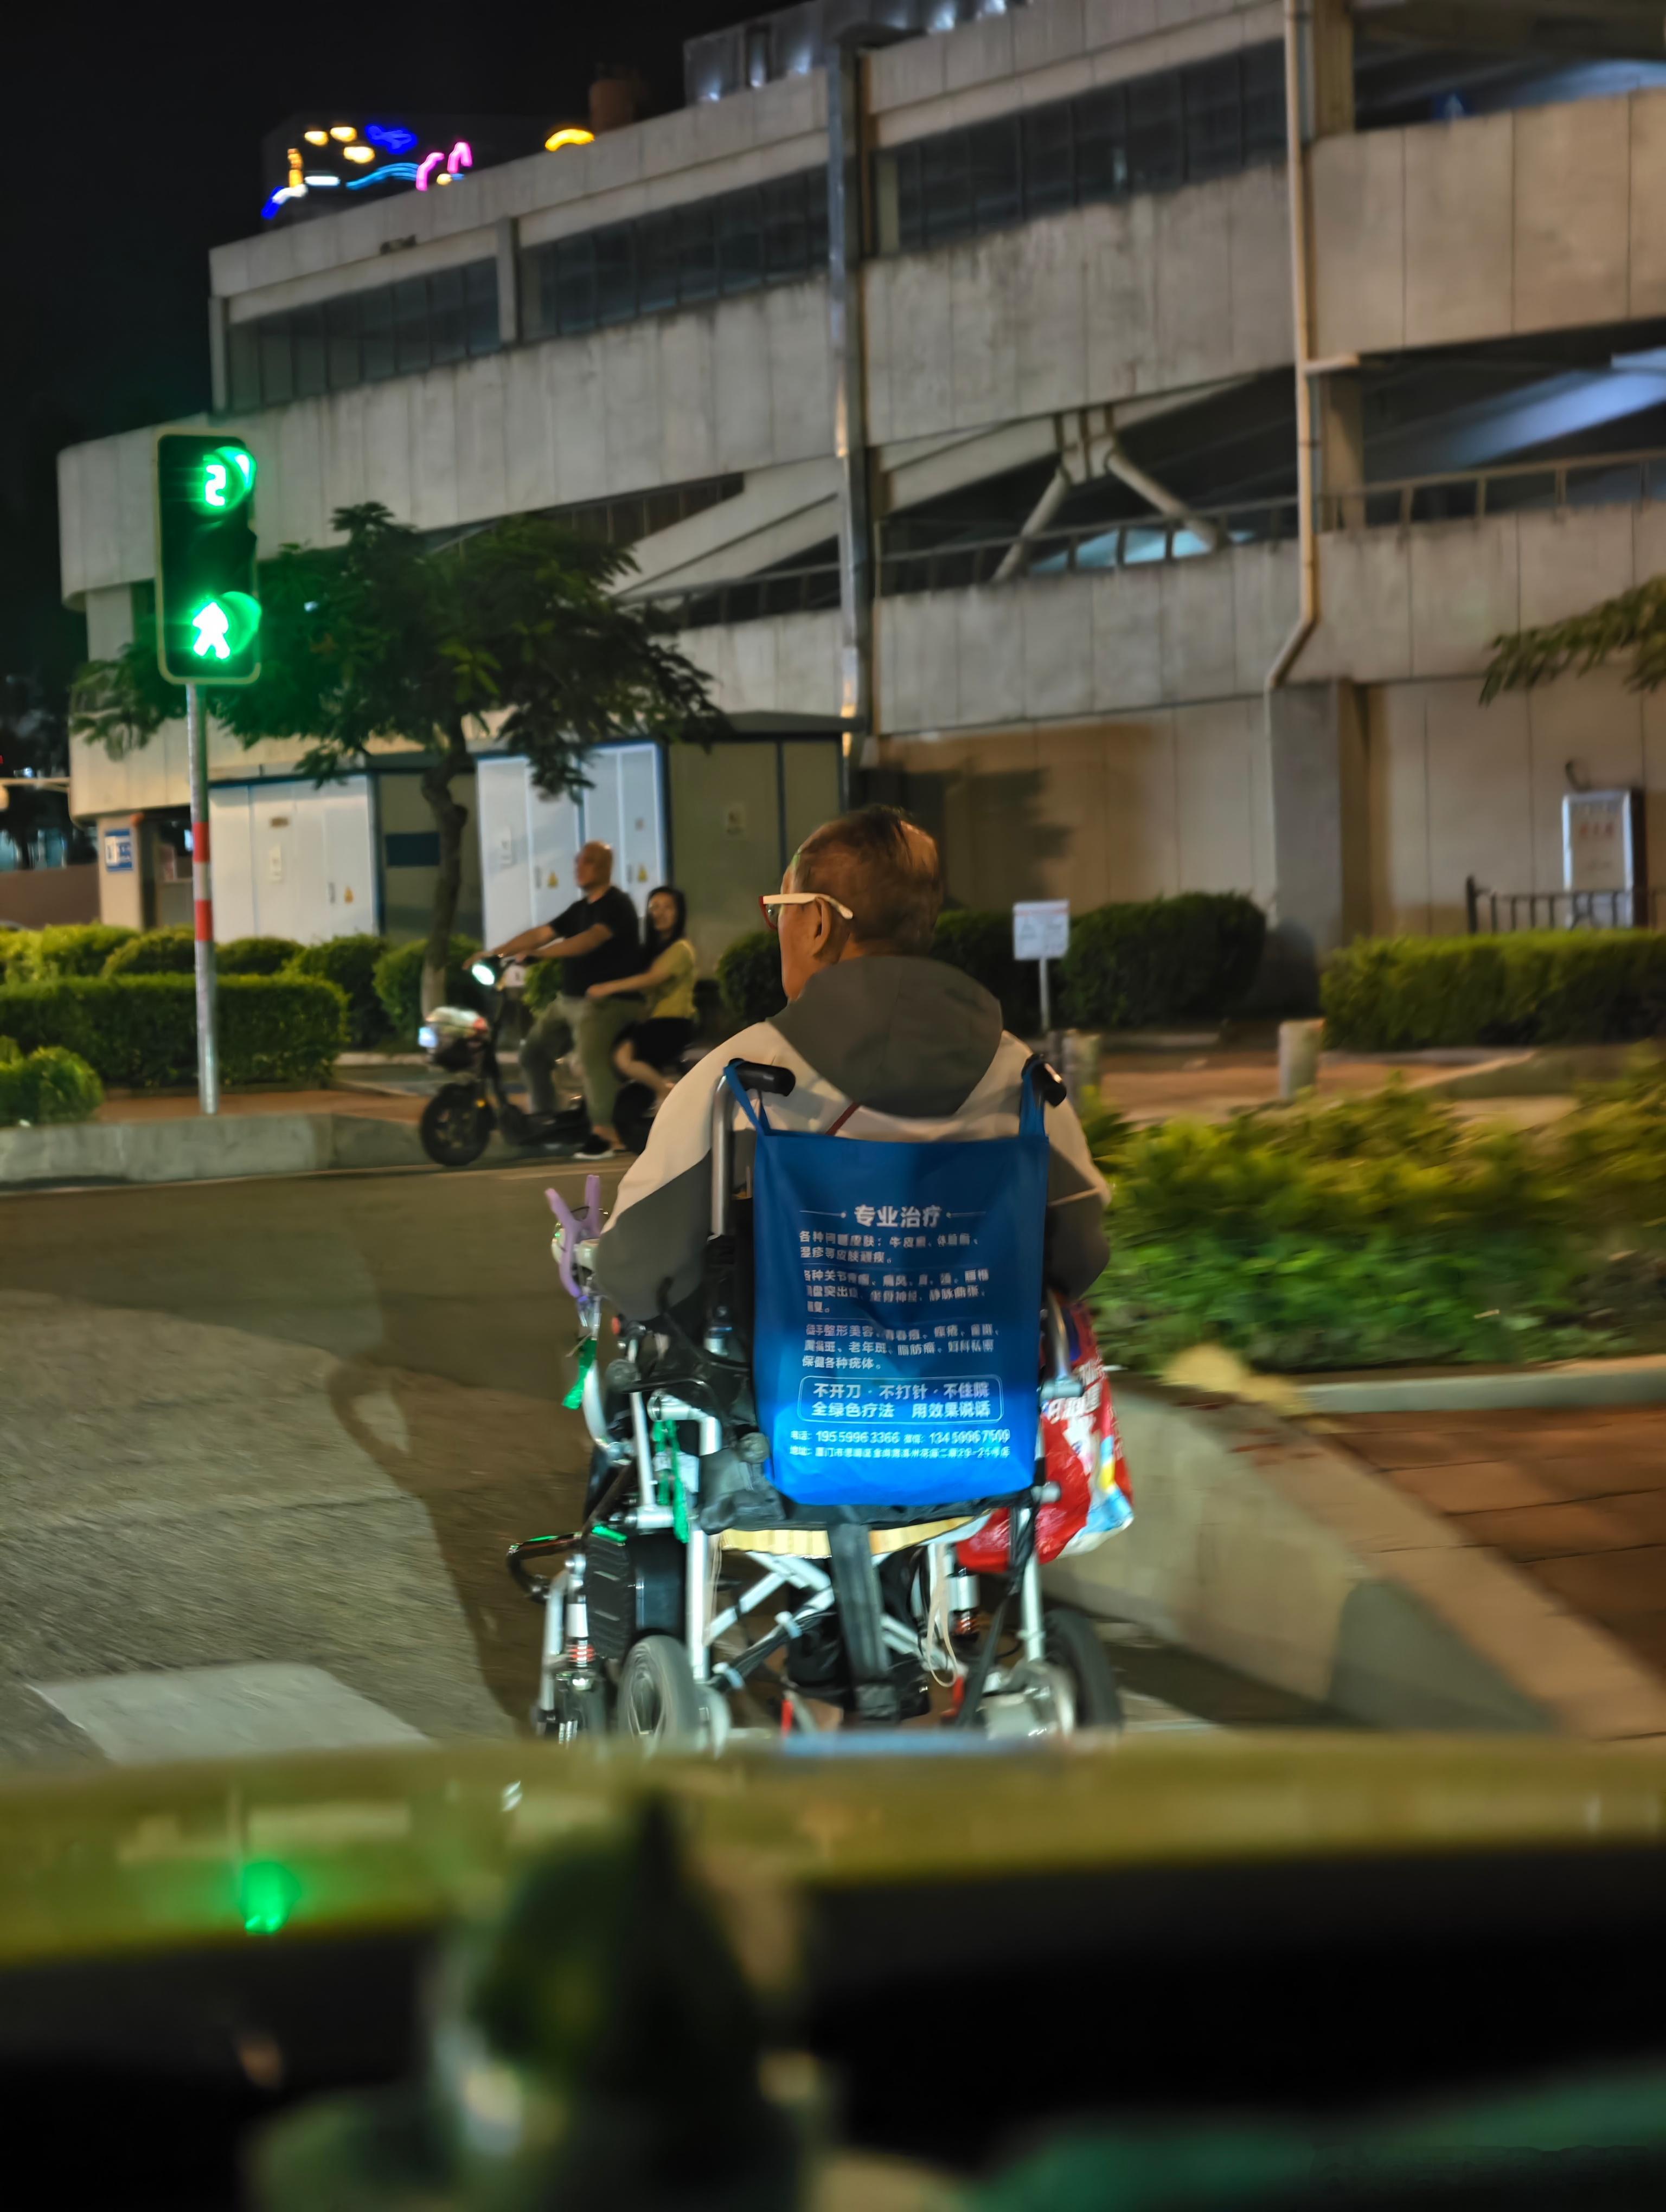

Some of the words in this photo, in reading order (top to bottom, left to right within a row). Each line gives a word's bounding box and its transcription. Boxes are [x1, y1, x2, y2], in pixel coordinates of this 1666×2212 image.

[203, 464, 227, 507] 2
[854, 1204, 942, 1228] 专业治疗
[811, 1401, 895, 1418] 全绿色疗法
[912, 1400, 991, 1419] 用效果说话
